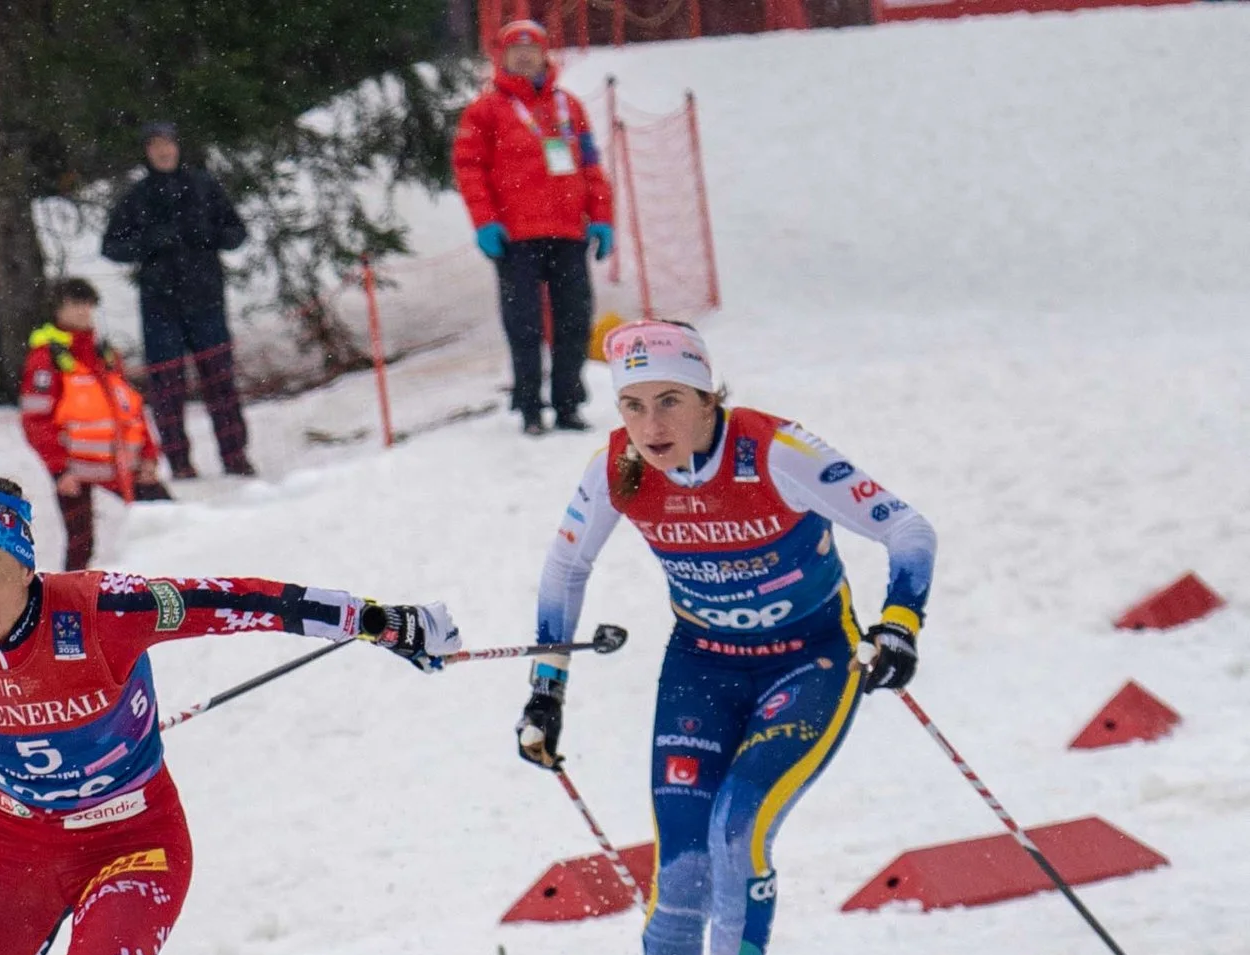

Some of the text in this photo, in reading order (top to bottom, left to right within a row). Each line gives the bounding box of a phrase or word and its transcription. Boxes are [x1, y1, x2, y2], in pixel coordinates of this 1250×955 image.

[656, 515, 784, 545] GENERALI
[718, 551, 780, 573] 2023
[131, 689, 148, 719] 5
[15, 739, 63, 776] 5
[656, 734, 722, 754] SCANIA
[74, 880, 149, 926] CRAFT
